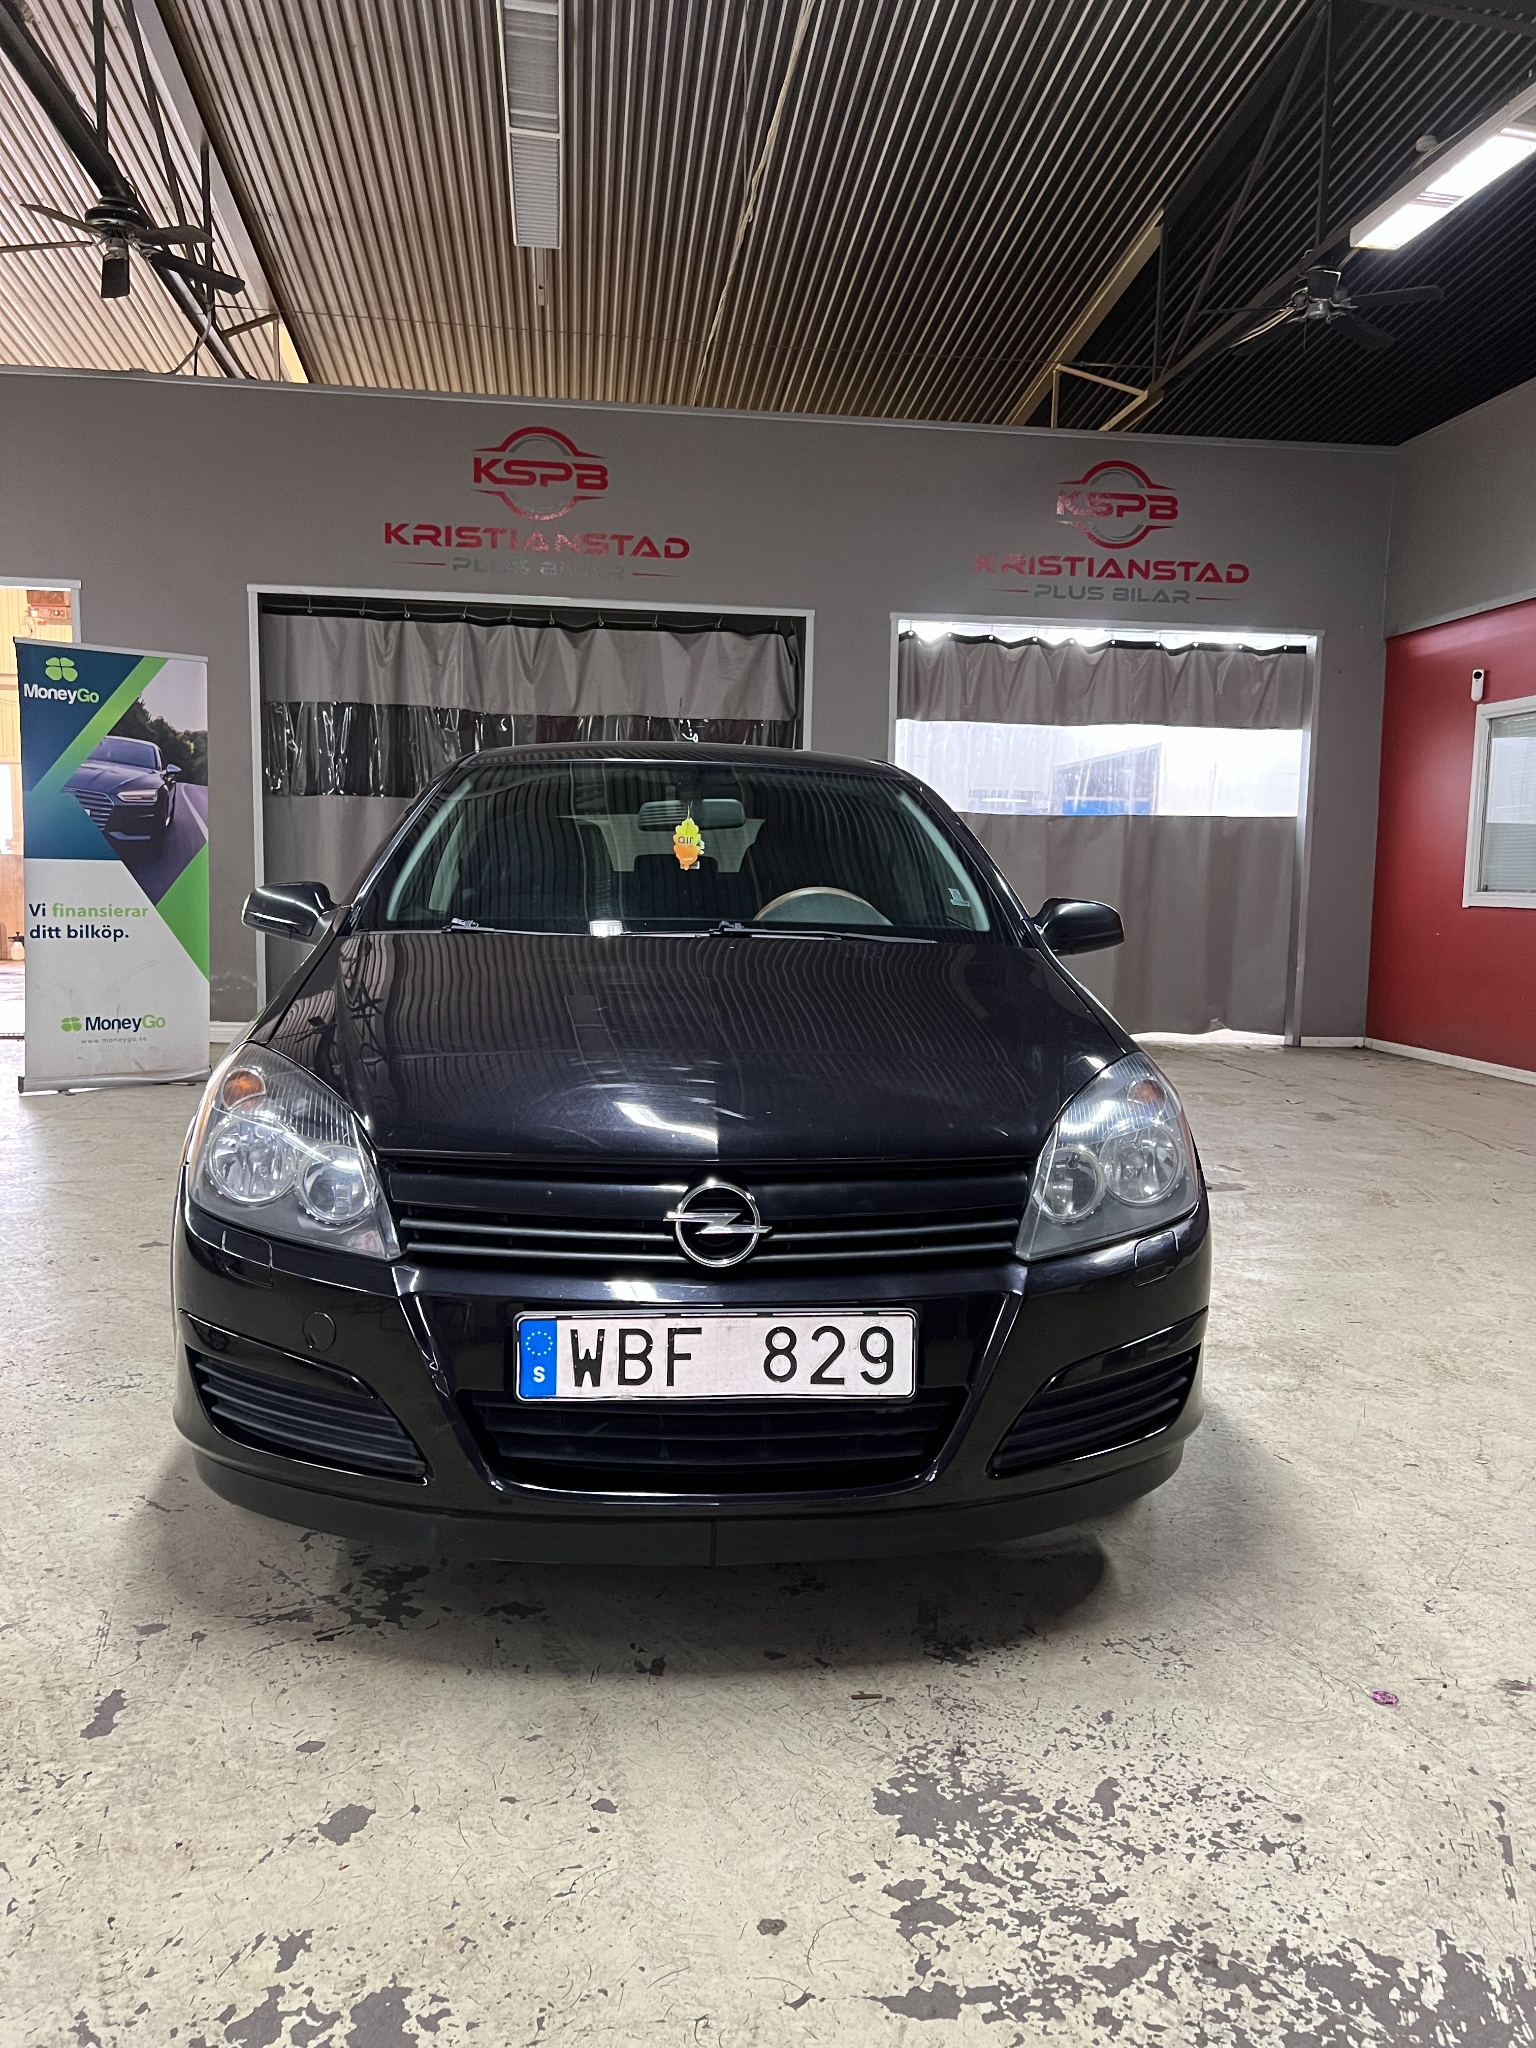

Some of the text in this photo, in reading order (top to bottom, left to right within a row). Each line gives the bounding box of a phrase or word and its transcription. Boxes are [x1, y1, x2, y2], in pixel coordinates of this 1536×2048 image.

[473, 457, 609, 490] KSPB
[1056, 490, 1179, 520] KSPB
[384, 522, 690, 559] KRISTIANSTAD
[974, 552, 1250, 583] KRISTIANSTAD
[1034, 584, 1190, 603] PLUS BILAR
[23, 683, 100, 704] MoneyGo
[29, 903, 149, 917] Vi finansierar
[29, 924, 130, 942] ditt bilköp.
[85, 1014, 166, 1032] MoneyGo
[81, 1036, 147, 1044] www.moneygo.se
[569, 1325, 895, 1388] WBF 829
[532, 1366, 546, 1383] S
